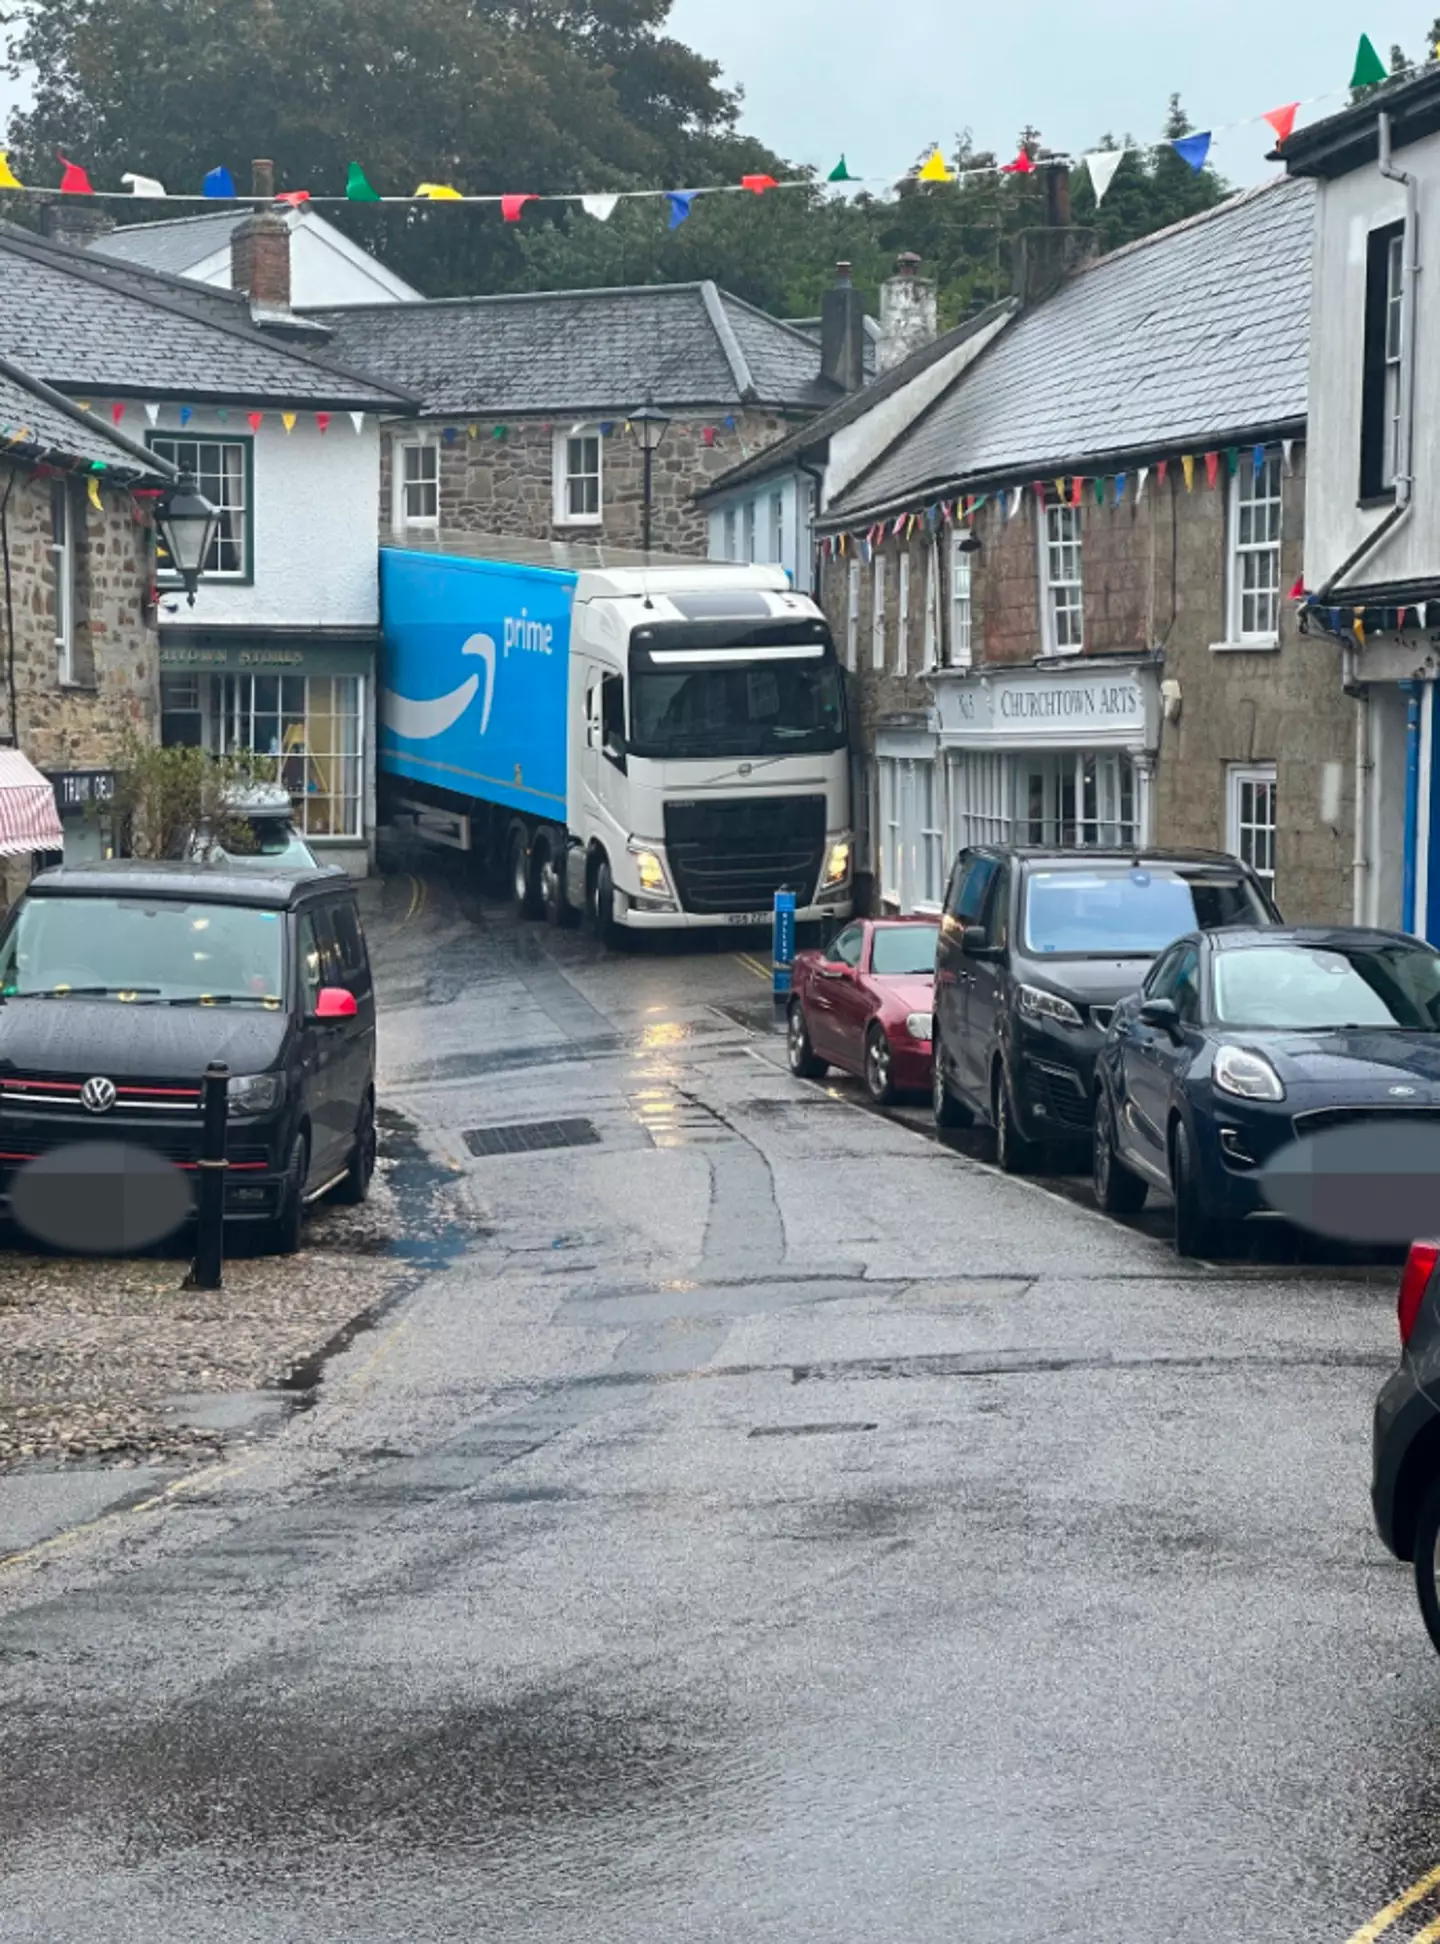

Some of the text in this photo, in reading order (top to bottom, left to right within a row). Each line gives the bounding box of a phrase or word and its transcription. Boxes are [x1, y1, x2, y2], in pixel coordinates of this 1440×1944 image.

[503, 607, 553, 659] prime
[1000, 688, 1096, 718] CHURCHTOWN
[1099, 685, 1138, 715] ARTS
